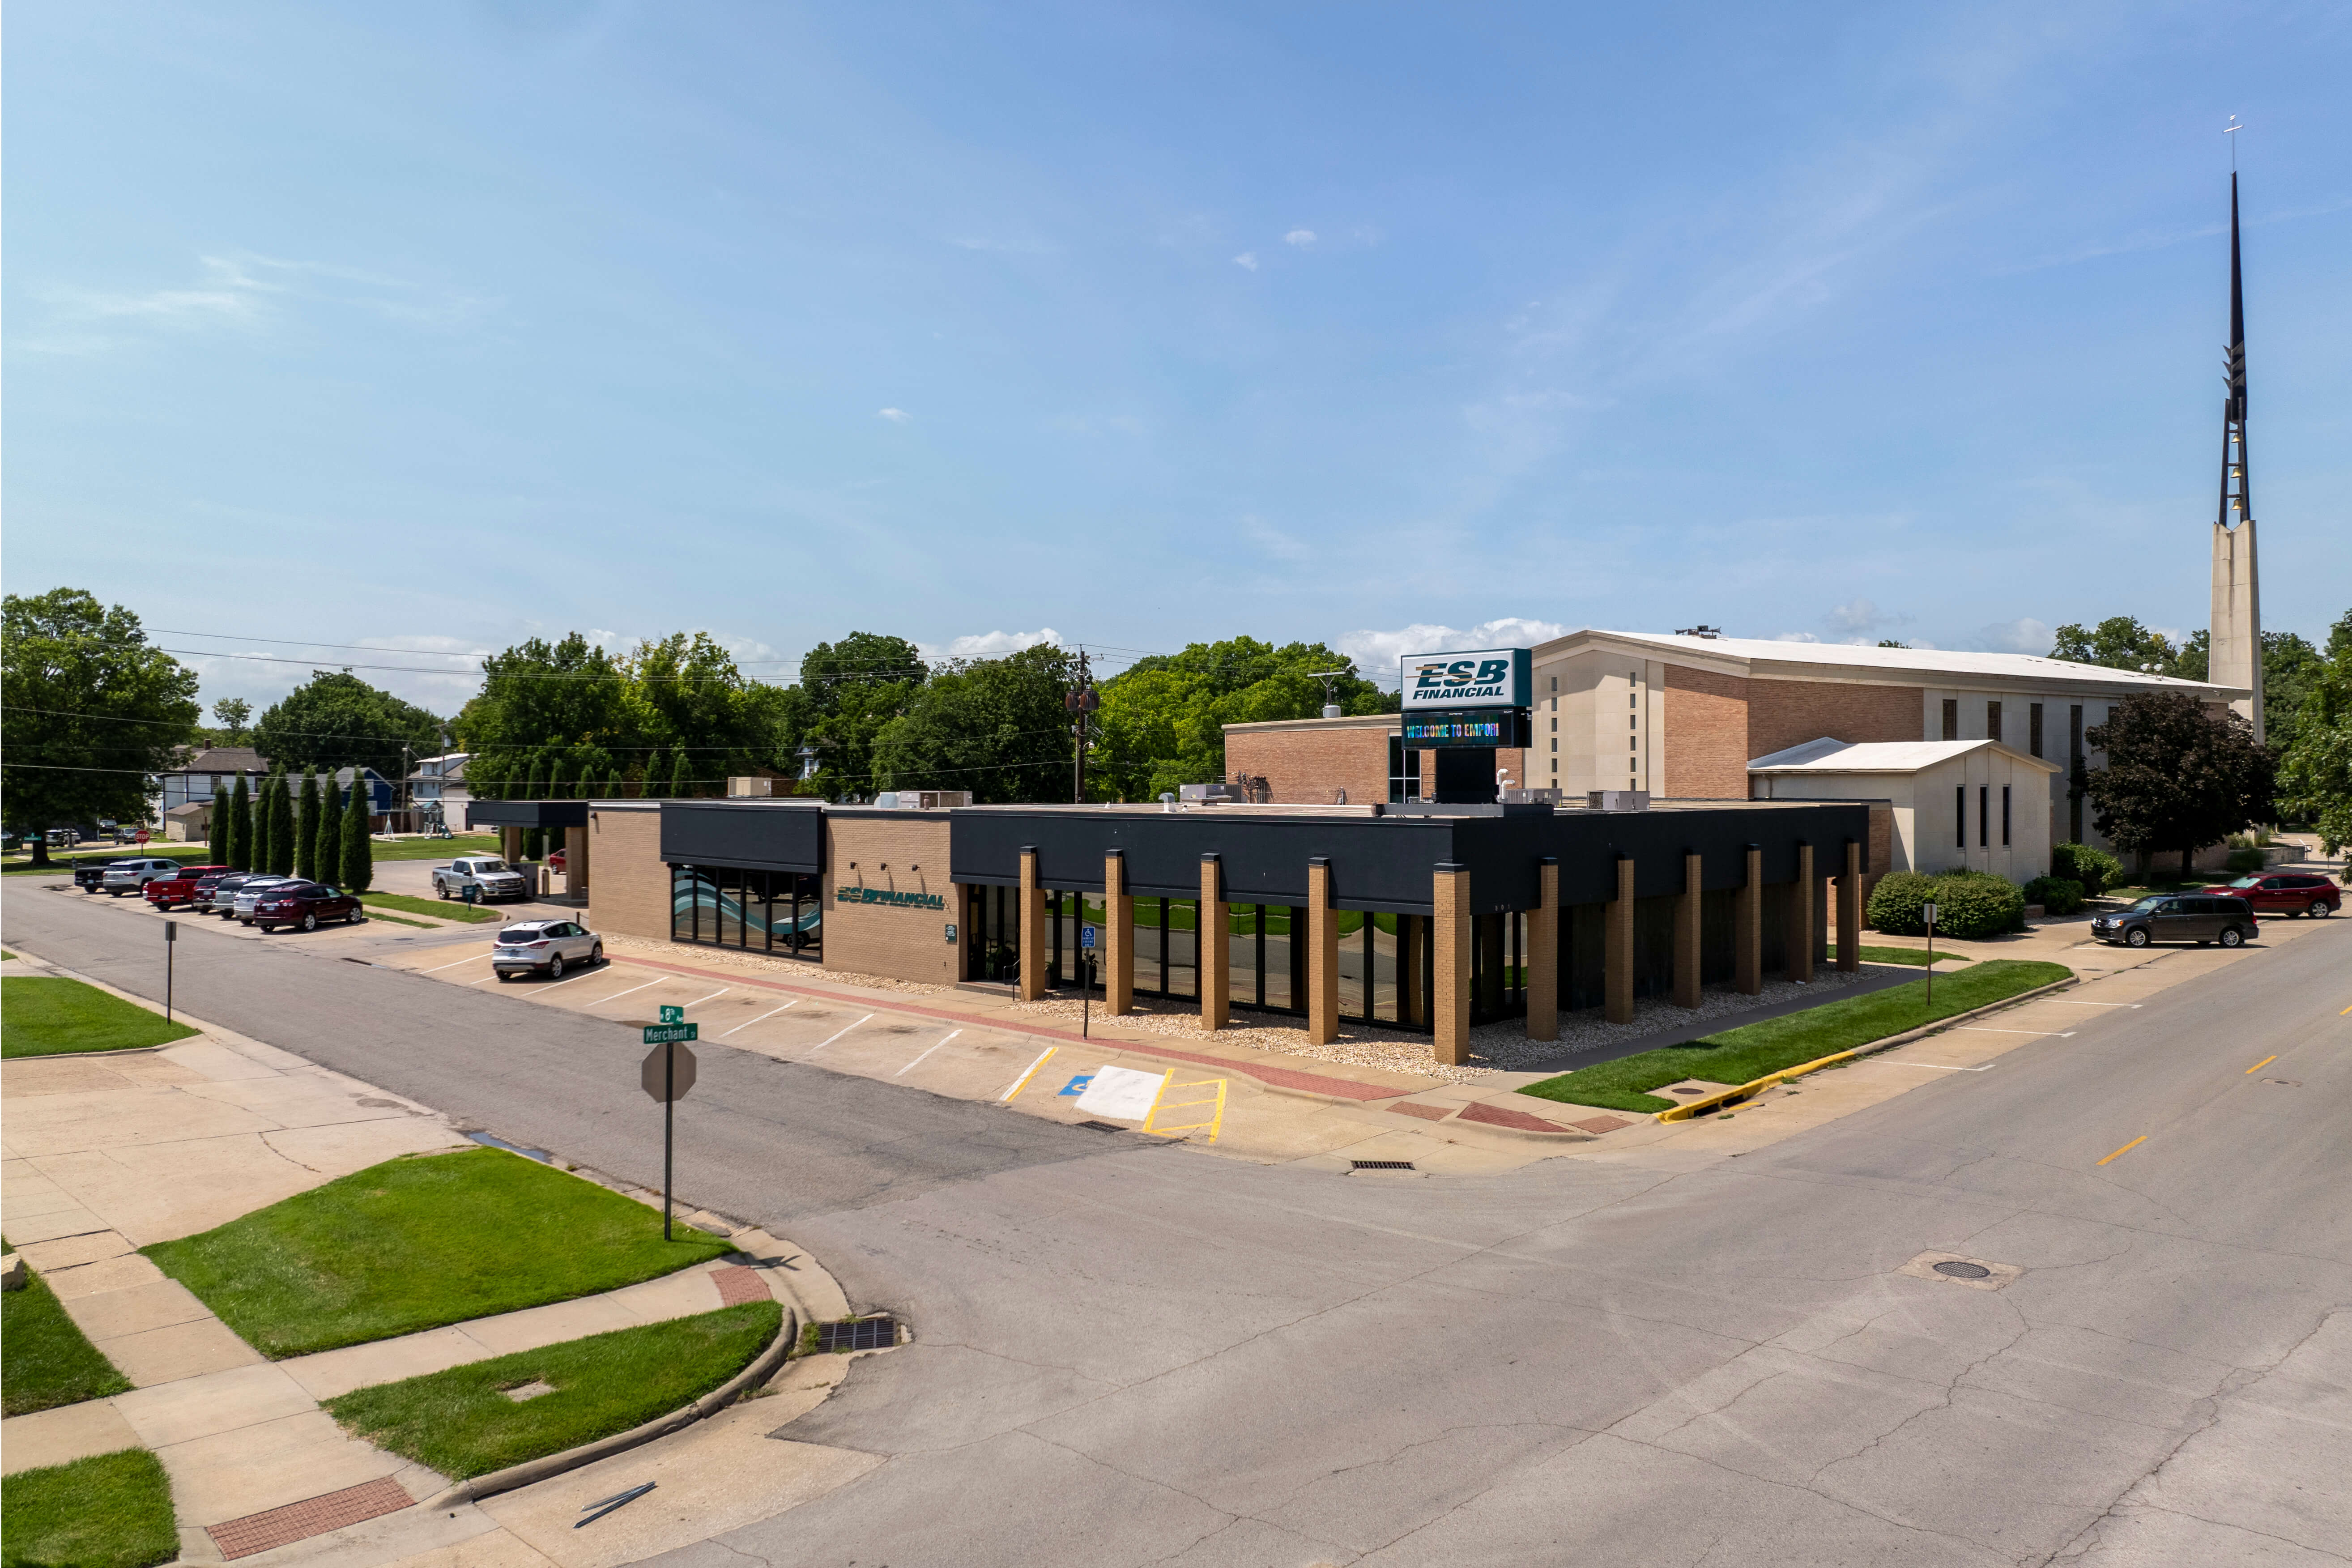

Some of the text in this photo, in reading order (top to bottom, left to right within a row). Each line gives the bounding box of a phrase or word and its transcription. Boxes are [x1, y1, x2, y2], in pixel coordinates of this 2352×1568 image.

[1415, 660, 1509, 688] ESB
[1412, 686, 1504, 700] FINANCIAL
[1407, 724, 1449, 738] WELCOME
[1451, 724, 1461, 737] TO
[837, 886, 945, 907] ESB FINANCIAL
[646, 1026, 687, 1042] Merchant
